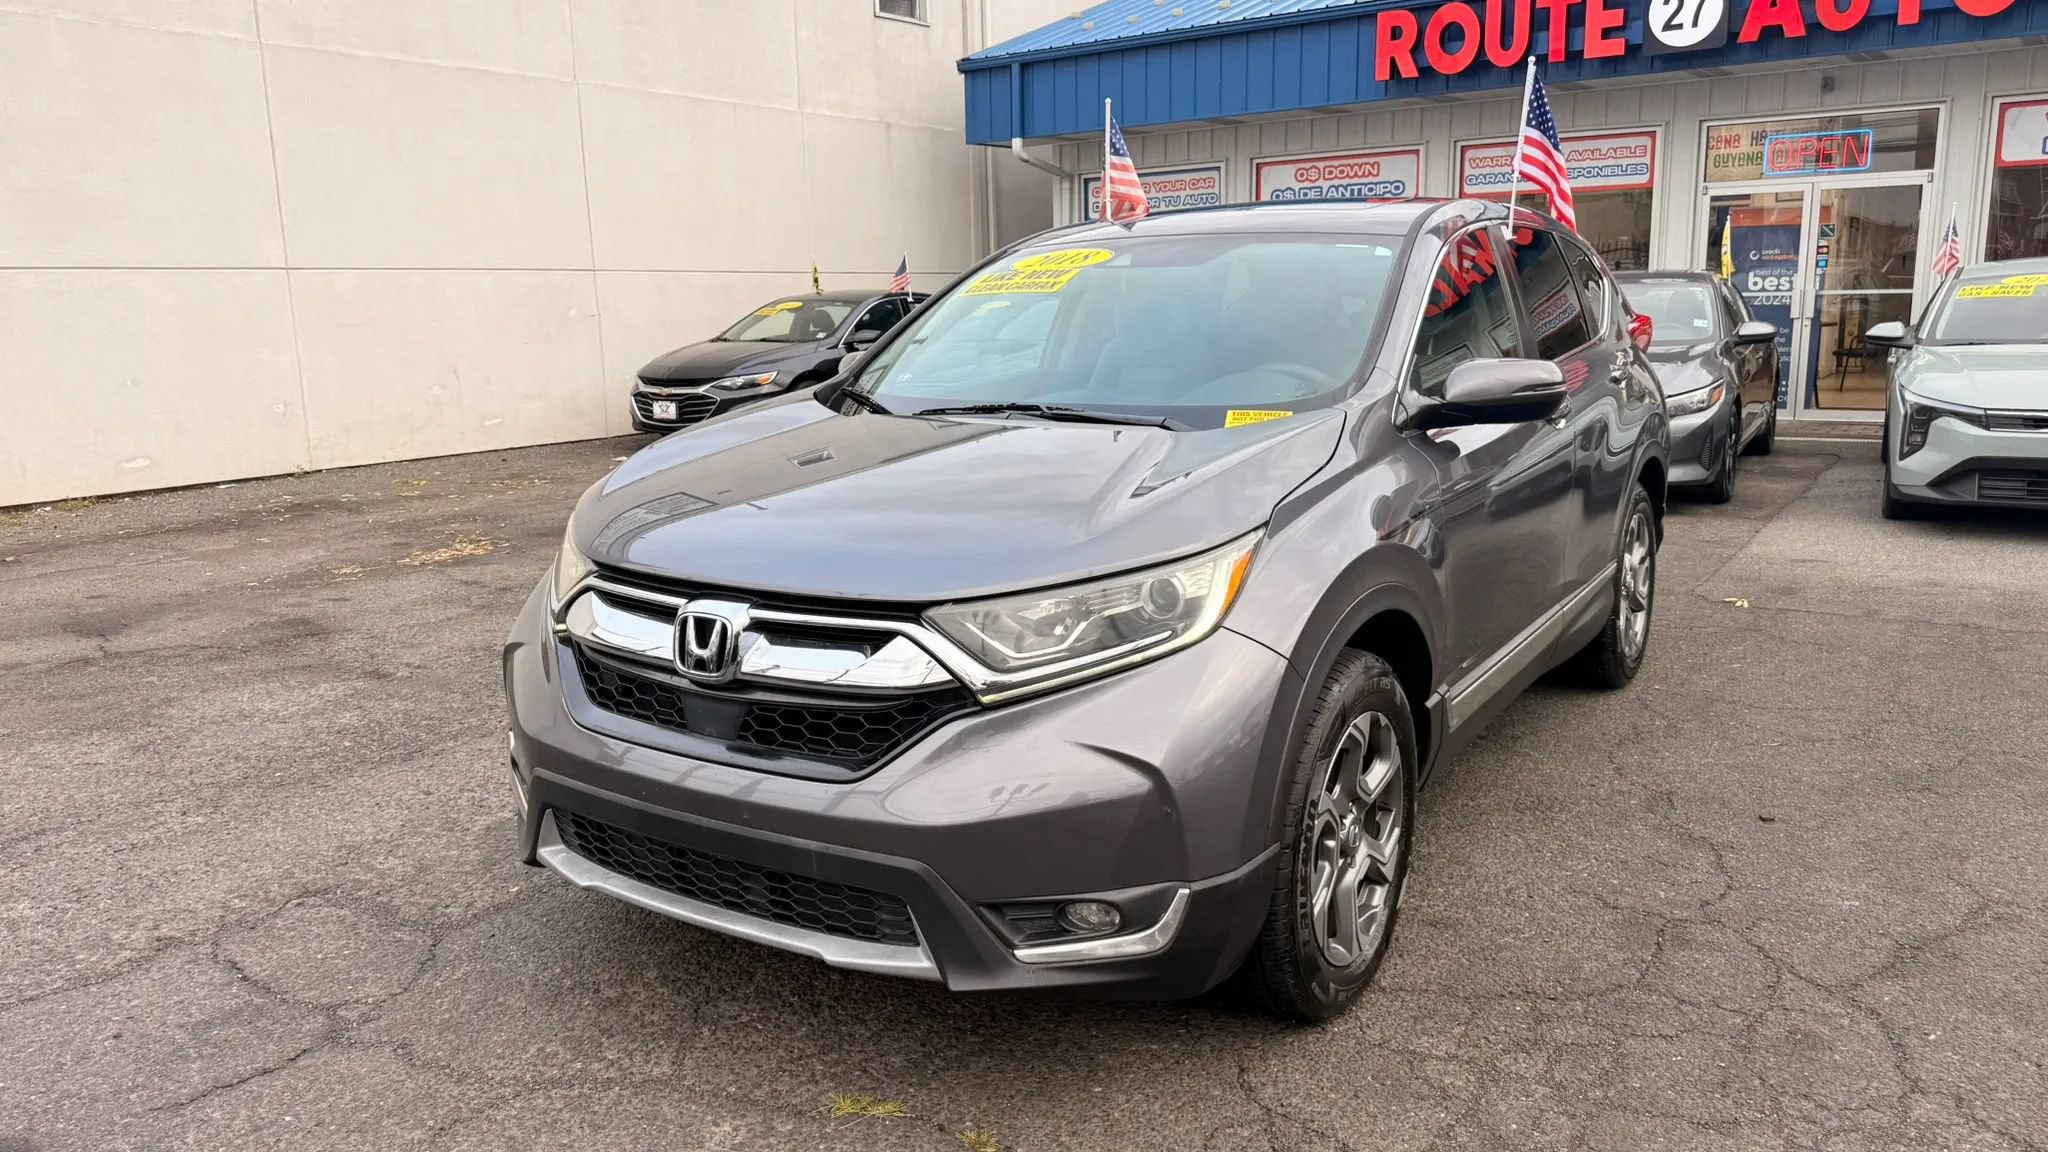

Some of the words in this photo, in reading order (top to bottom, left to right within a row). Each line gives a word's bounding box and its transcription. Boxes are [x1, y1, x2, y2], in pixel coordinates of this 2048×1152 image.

[1375, 0, 1626, 81] ROUTE
[1660, 0, 1702, 33] 27
[1566, 145, 1647, 162] AVAILABLE
[1714, 150, 1763, 168] GUYANA
[1768, 135, 1870, 171] OPEN
[1323, 161, 1380, 180] DOWN
[1153, 180, 1187, 194] YOUR
[1189, 177, 1216, 190] CAR
[1298, 186, 1323, 199] DE
[1324, 180, 1405, 199] ANTICIPO
[1162, 196, 1180, 207] TU
[1182, 193, 1218, 206] AUTO
[1022, 249, 1101, 268] 2018
[978, 270, 1024, 284] LIKE
[1020, 268, 1074, 281] NEW
[1755, 268, 1771, 276] best
[1772, 268, 1781, 276] of
[1781, 268, 1793, 276] the
[1004, 280, 1063, 293] CARFAX
[1753, 294, 1791, 305] 2024
